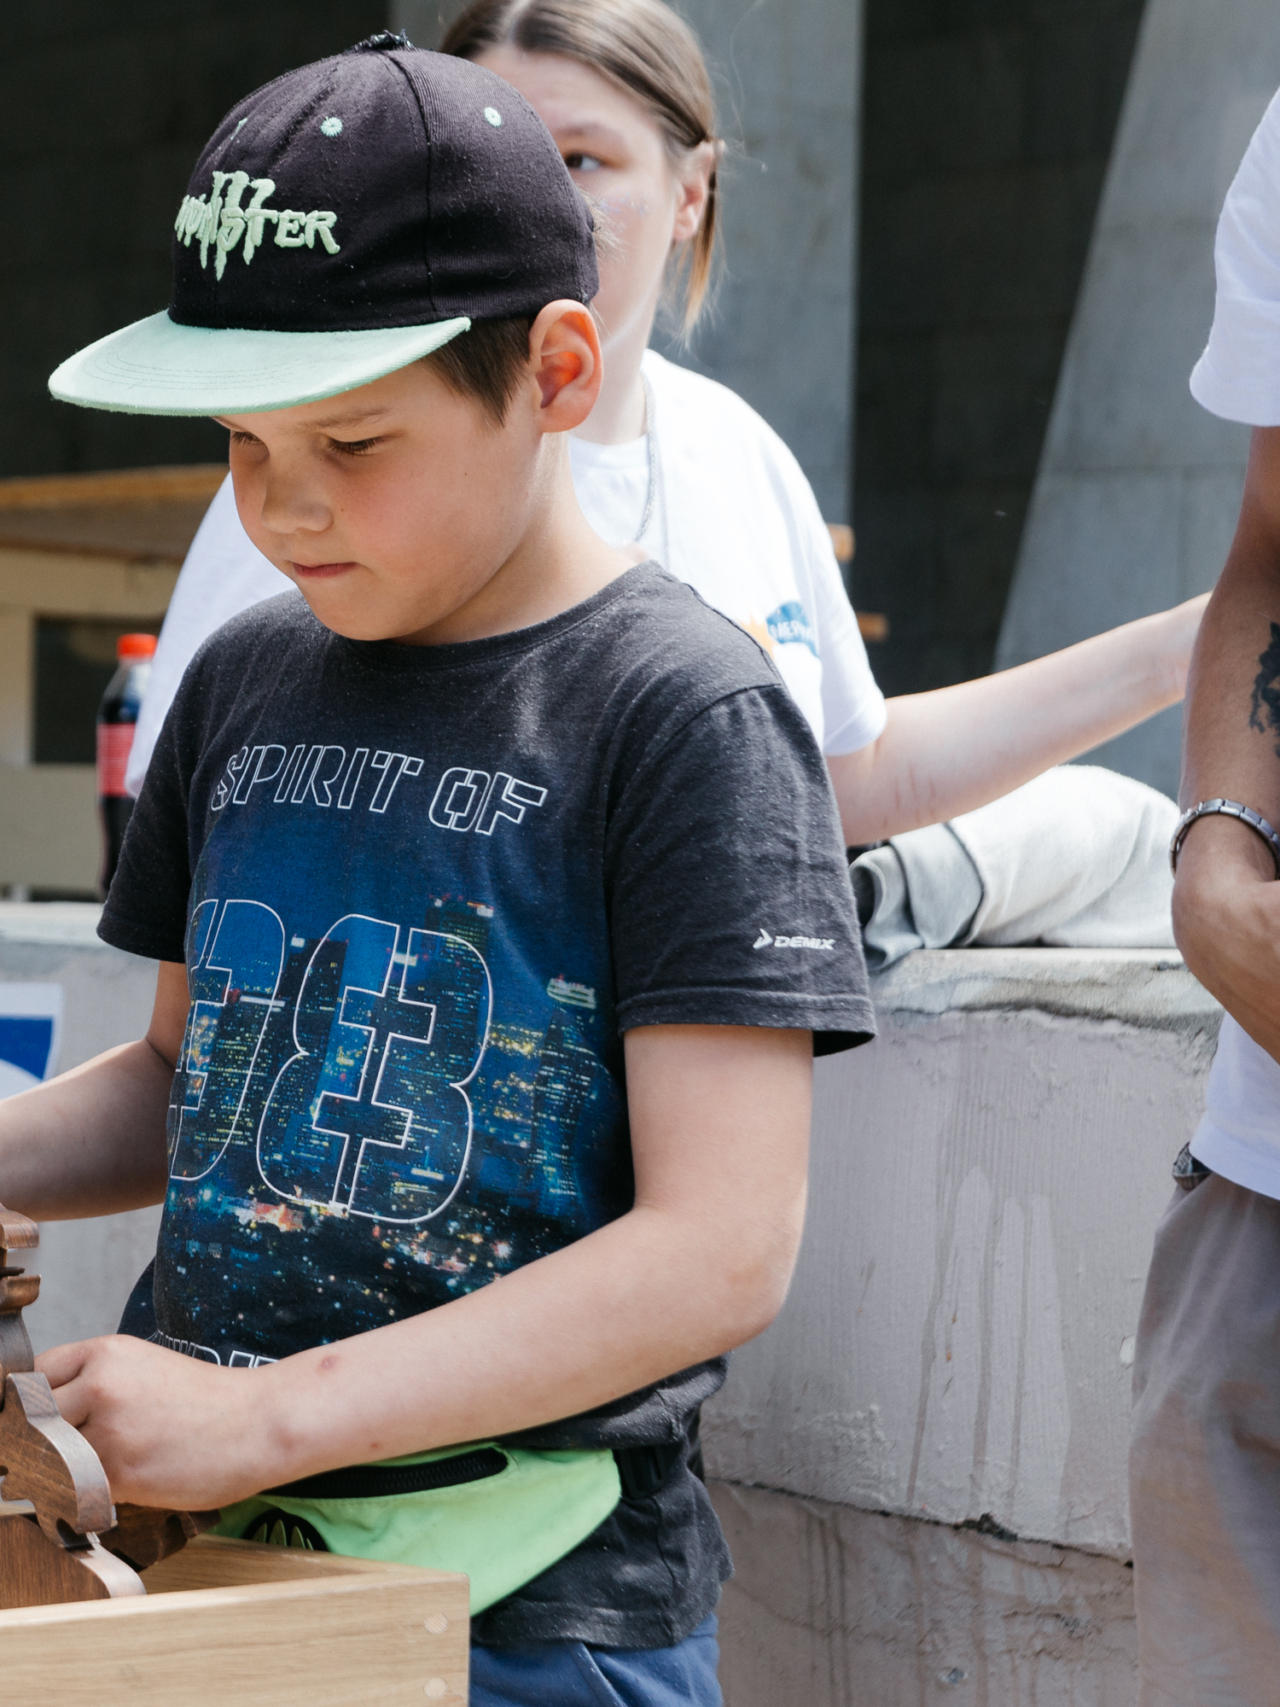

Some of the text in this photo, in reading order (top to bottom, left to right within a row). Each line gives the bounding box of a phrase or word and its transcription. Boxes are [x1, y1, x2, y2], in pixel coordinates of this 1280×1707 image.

[174, 193, 341, 256] MONSTER
[211, 744, 547, 835] SPIRIT OF
[774, 935, 836, 950] DEMIX
